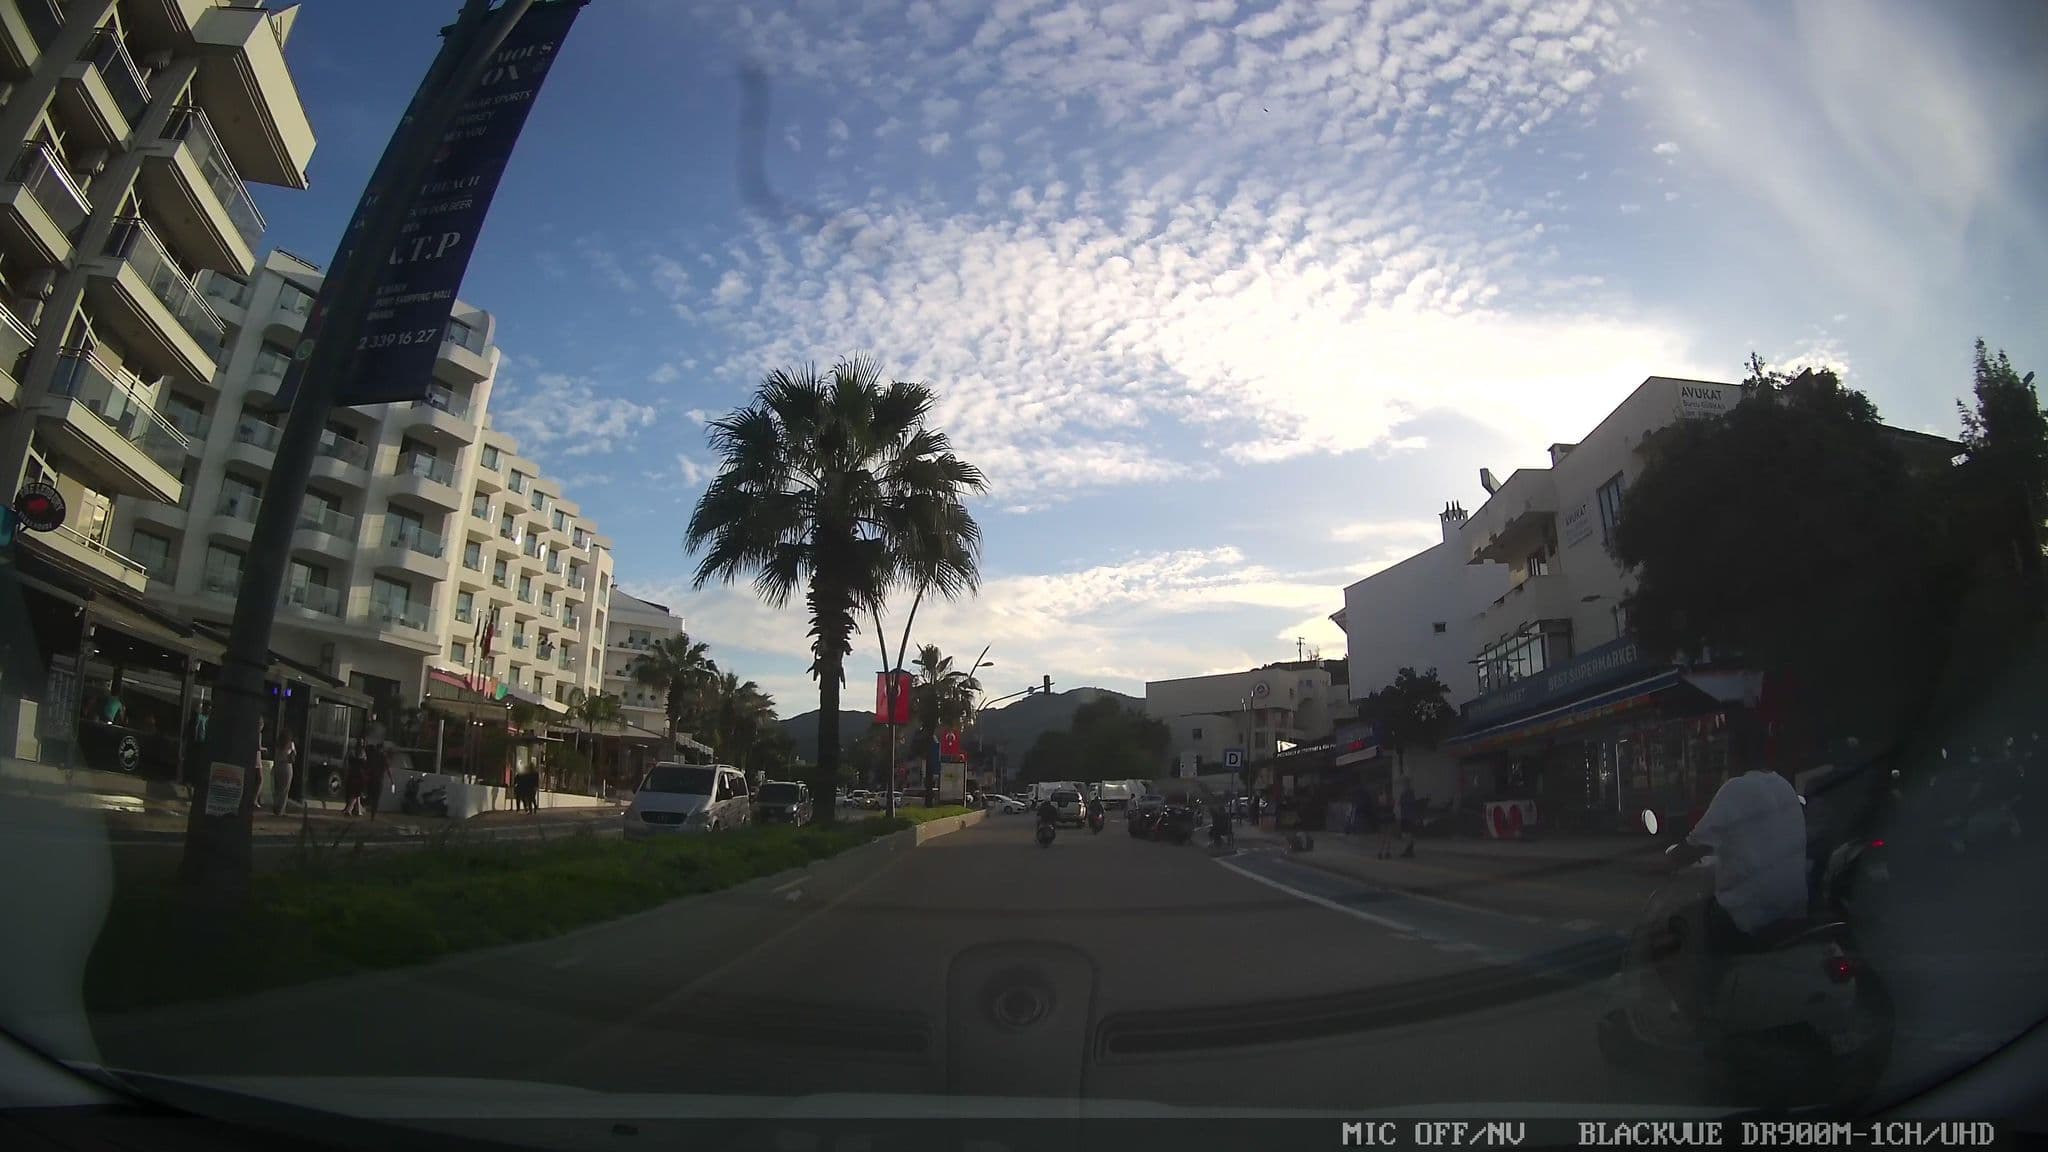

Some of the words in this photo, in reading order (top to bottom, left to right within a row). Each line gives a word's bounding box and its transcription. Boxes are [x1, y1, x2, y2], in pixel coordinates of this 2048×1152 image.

[414, 328, 438, 344] 27
[1681, 386, 1722, 401] AVUKAT
[1569, 642, 1640, 685] SUPERMARKET
[1229, 753, 1239, 765] D
